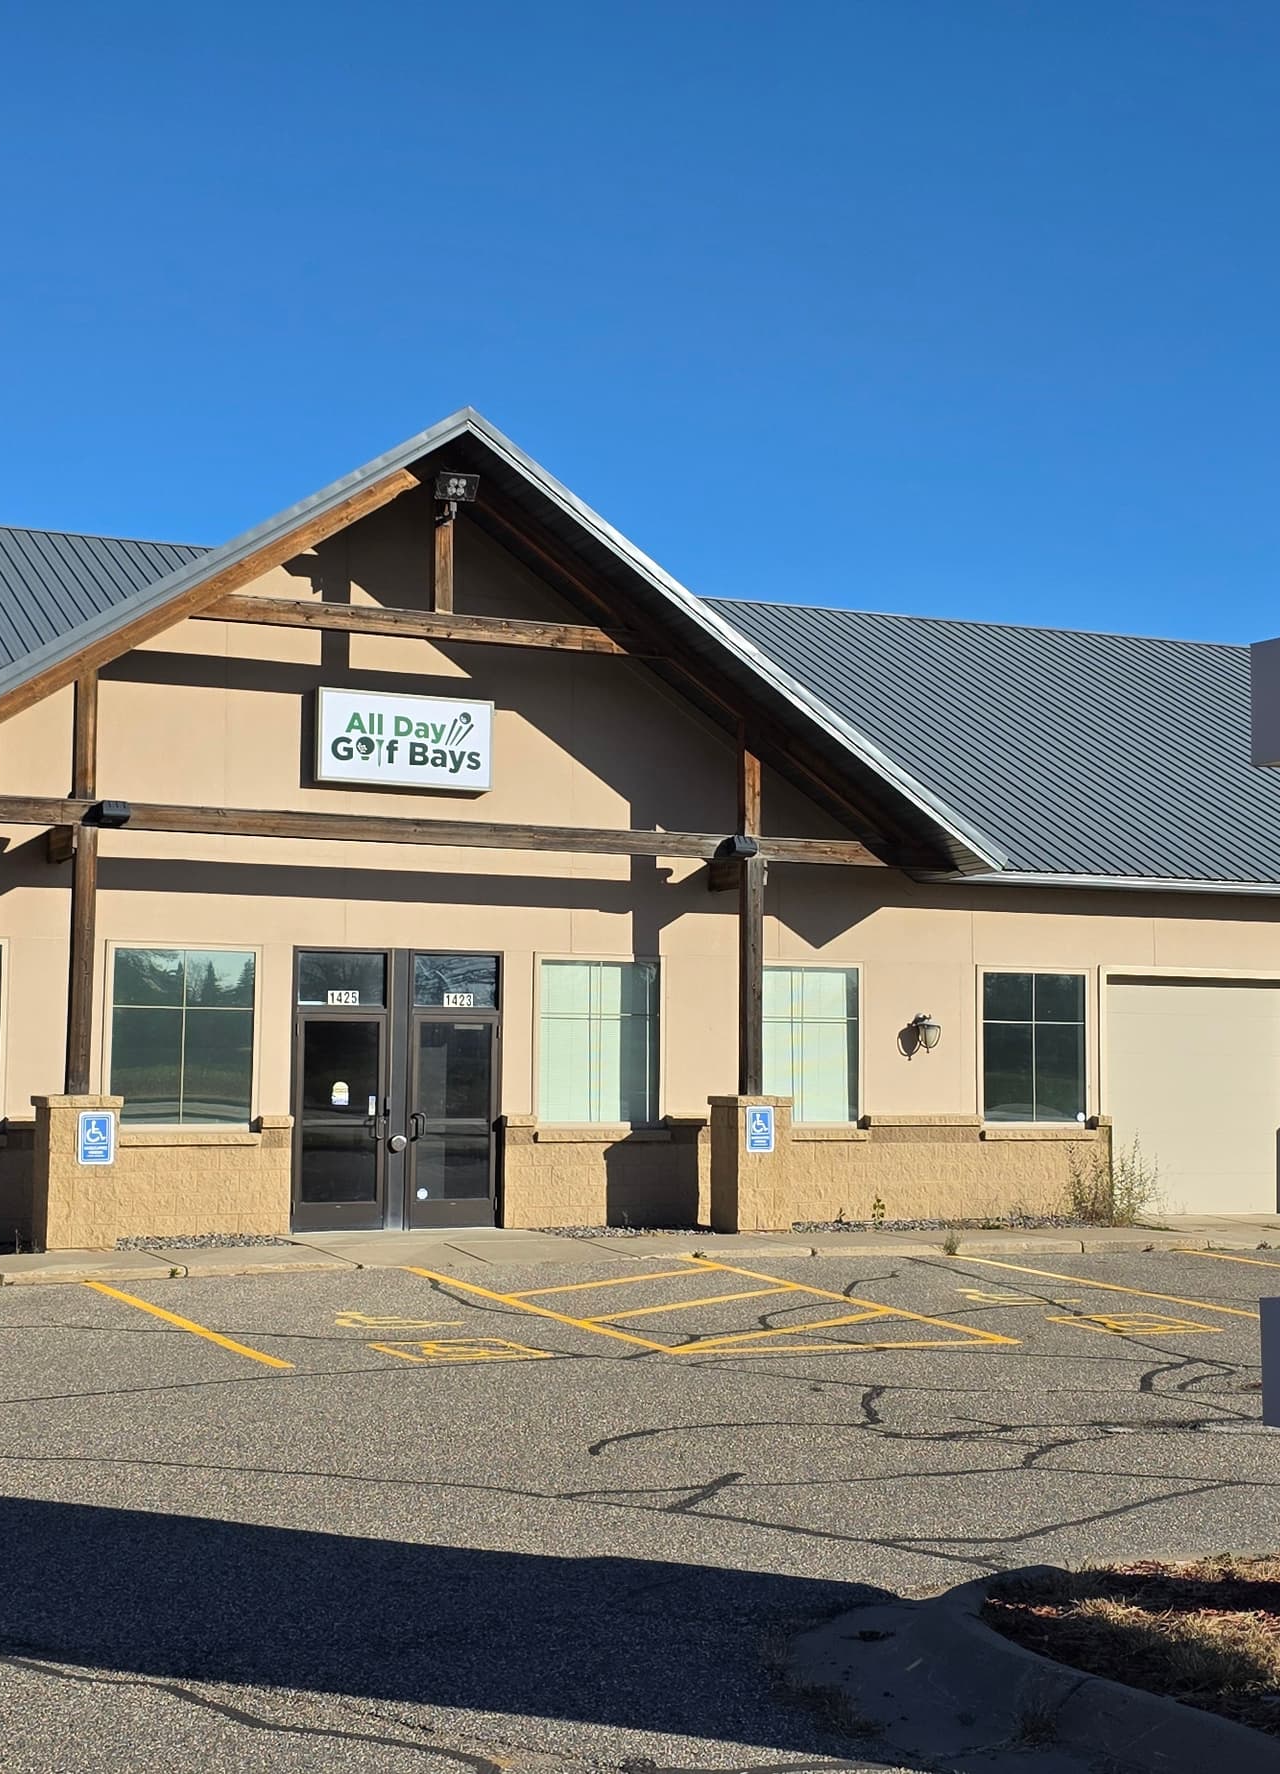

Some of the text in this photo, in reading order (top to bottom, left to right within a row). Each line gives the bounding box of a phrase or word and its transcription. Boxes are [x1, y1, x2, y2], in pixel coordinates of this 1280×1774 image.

[345, 712, 446, 744] All Day
[331, 736, 481, 773] Golf Bays
[330, 992, 357, 1004] 1425
[446, 994, 472, 1007] 1423
